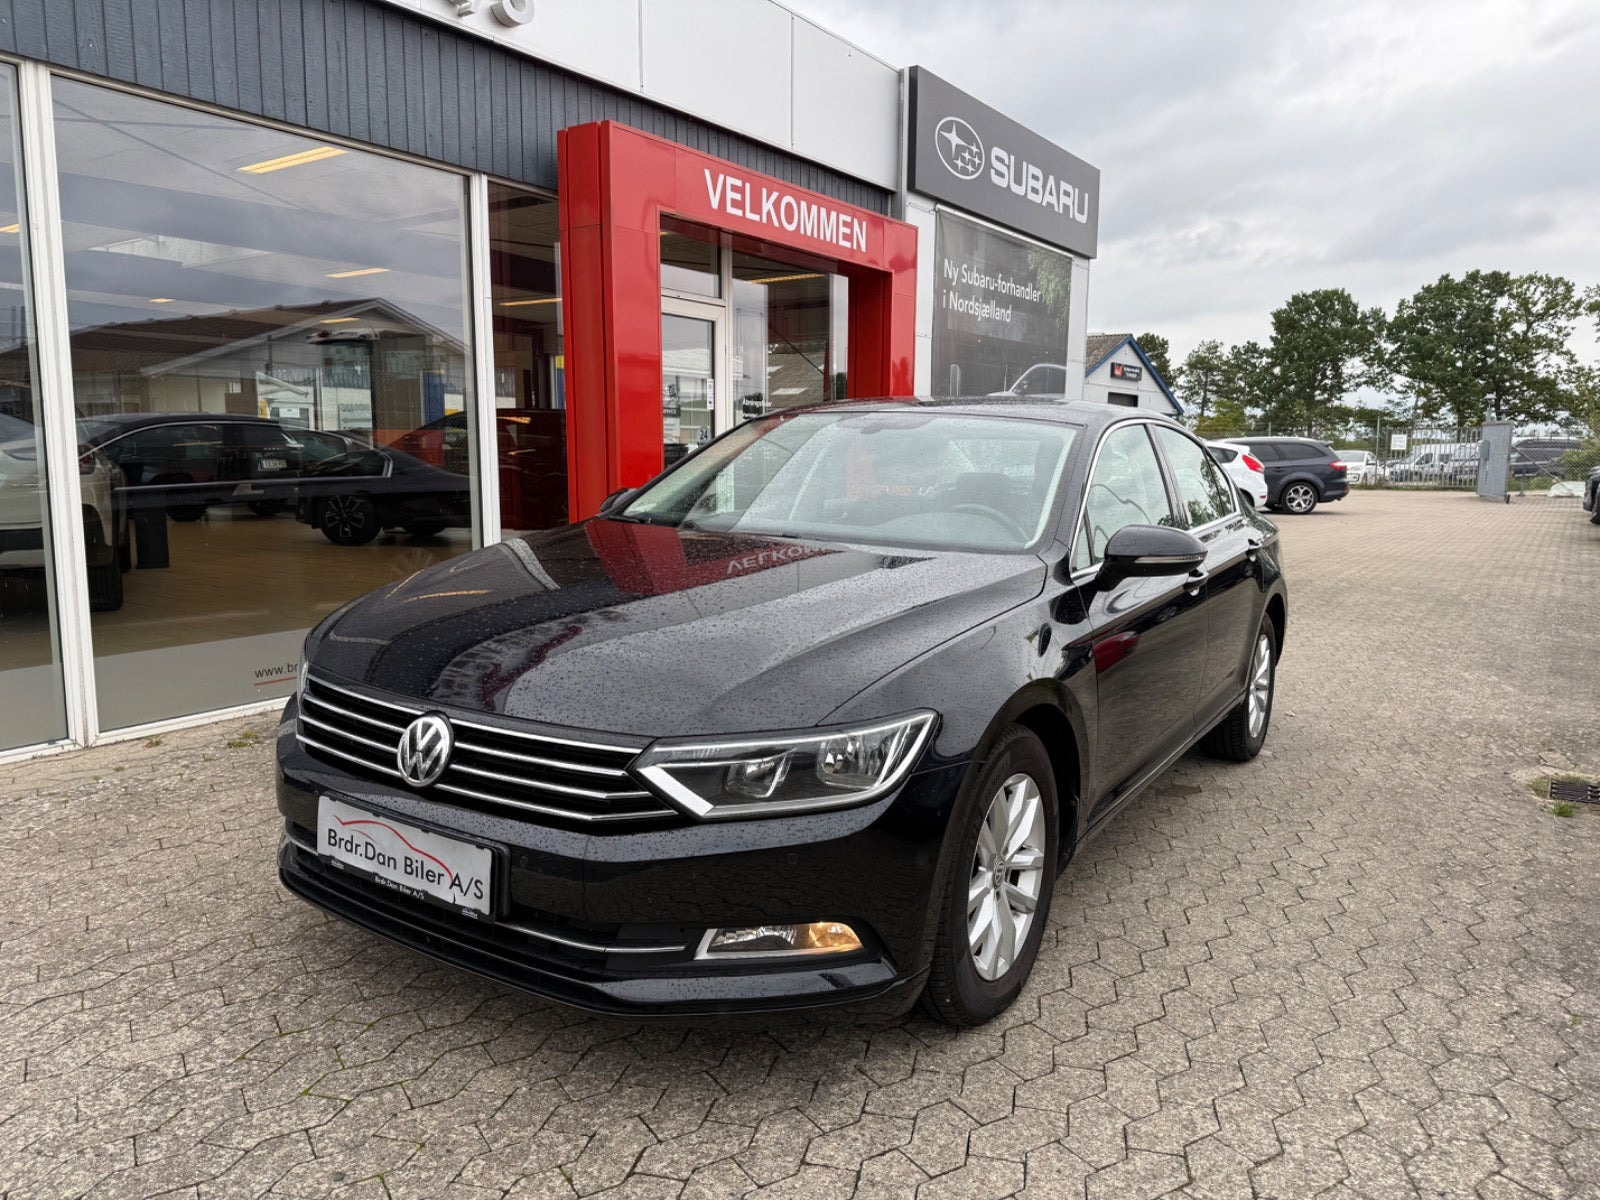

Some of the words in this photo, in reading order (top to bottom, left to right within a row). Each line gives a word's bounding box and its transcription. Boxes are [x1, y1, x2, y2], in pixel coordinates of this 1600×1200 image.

[990, 146, 1088, 224] SUBARU
[704, 168, 867, 253] VELKOMMEN
[943, 258, 959, 286] Ny
[961, 264, 1041, 303] Subaru-forhandler
[942, 289, 947, 309] i
[949, 290, 1012, 323] Nordsjælland
[254, 662, 299, 678] www.br
[404, 856, 445, 886] Biler
[449, 871, 484, 900] A/S
